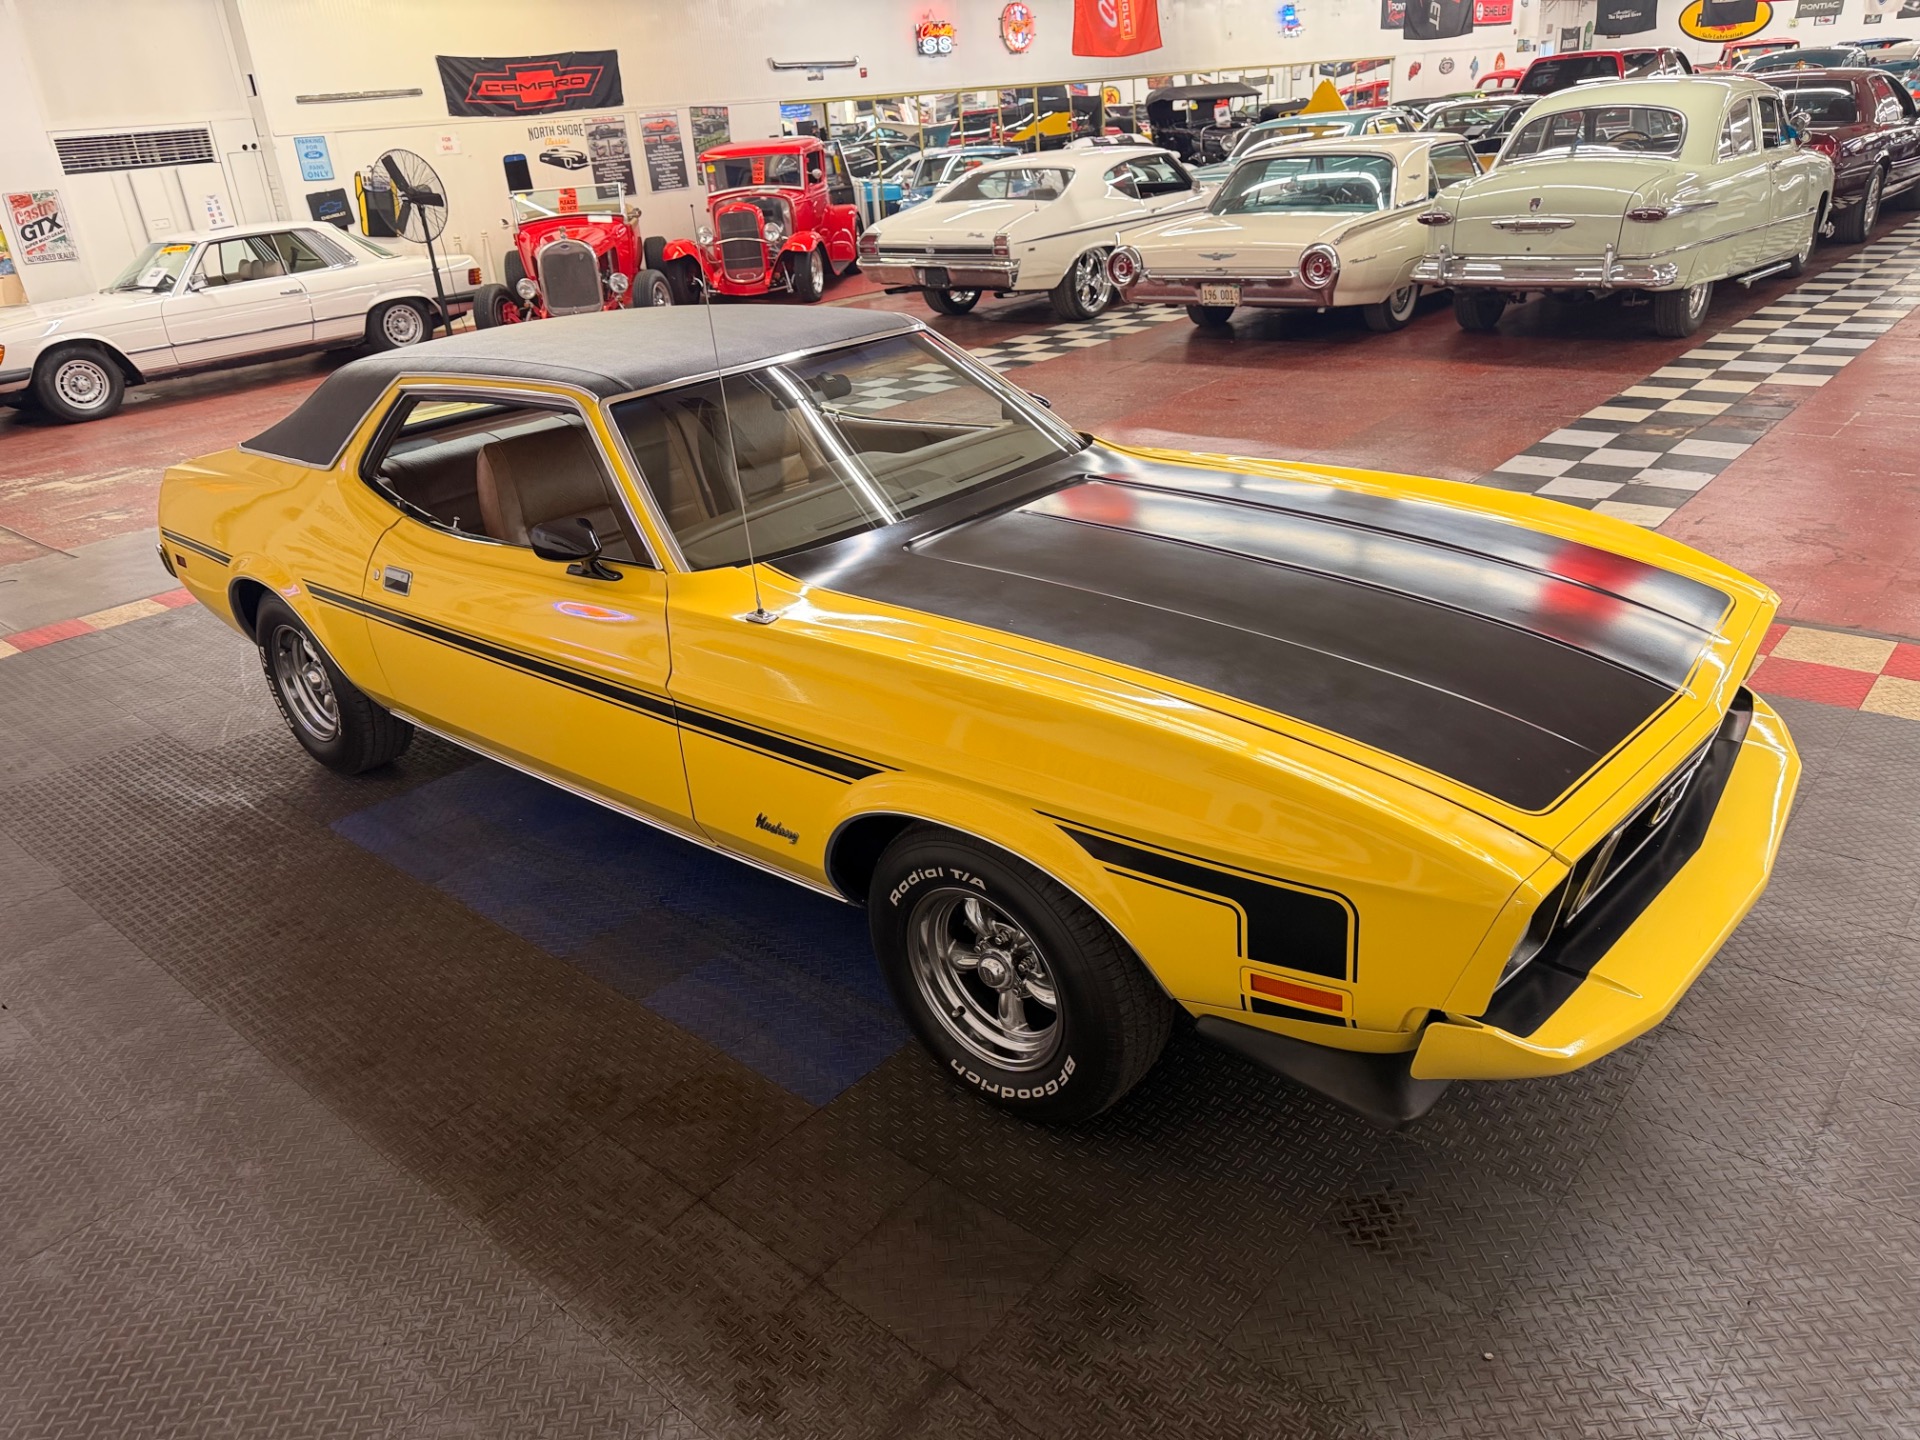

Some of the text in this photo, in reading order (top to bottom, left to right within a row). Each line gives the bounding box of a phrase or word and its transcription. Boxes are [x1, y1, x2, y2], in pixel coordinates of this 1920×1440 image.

[1391, 2, 1406, 11] PONT
[1800, 1, 1840, 11] PONTIAC
[1122, 0, 1132, 34] OLET
[1429, 0, 1441, 31] ET
[922, 36, 952, 54] SS
[485, 76, 585, 92] CAMARO
[527, 123, 584, 141] NORTH SHORE
[307, 171, 329, 179] ONLY
[20, 212, 63, 241] GTX
[25, 240, 39, 249] SUPER
[27, 251, 76, 263] AUTHORIZED DEALER
[1203, 289, 1217, 300] 196
[755, 812, 800, 844] Mustang
[889, 866, 987, 907] Radial T/A
[950, 1054, 1077, 1099] BFGoodrich
